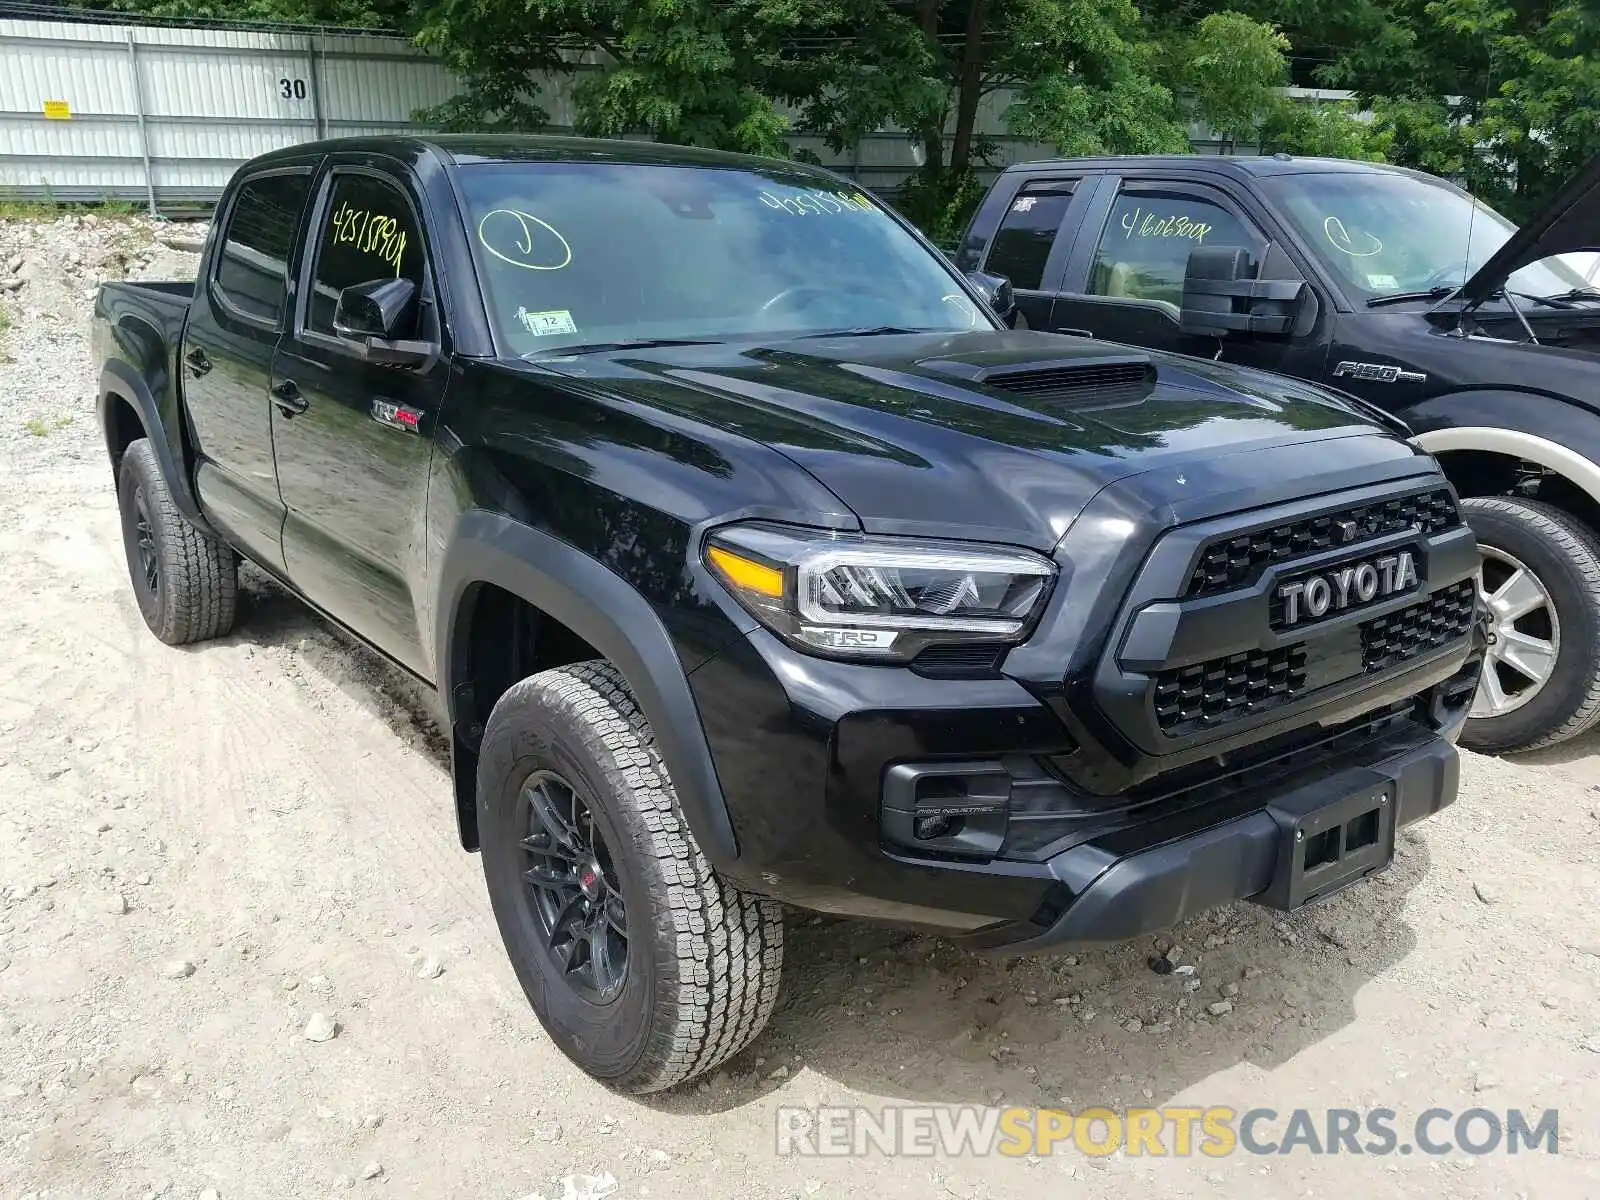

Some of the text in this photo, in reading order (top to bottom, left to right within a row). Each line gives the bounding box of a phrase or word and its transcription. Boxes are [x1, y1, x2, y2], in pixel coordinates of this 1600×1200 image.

[280, 78, 306, 99] 30
[542, 317, 558, 328] 12
[1278, 551, 1418, 624] TOYOTA
[823, 630, 878, 646] TRD
